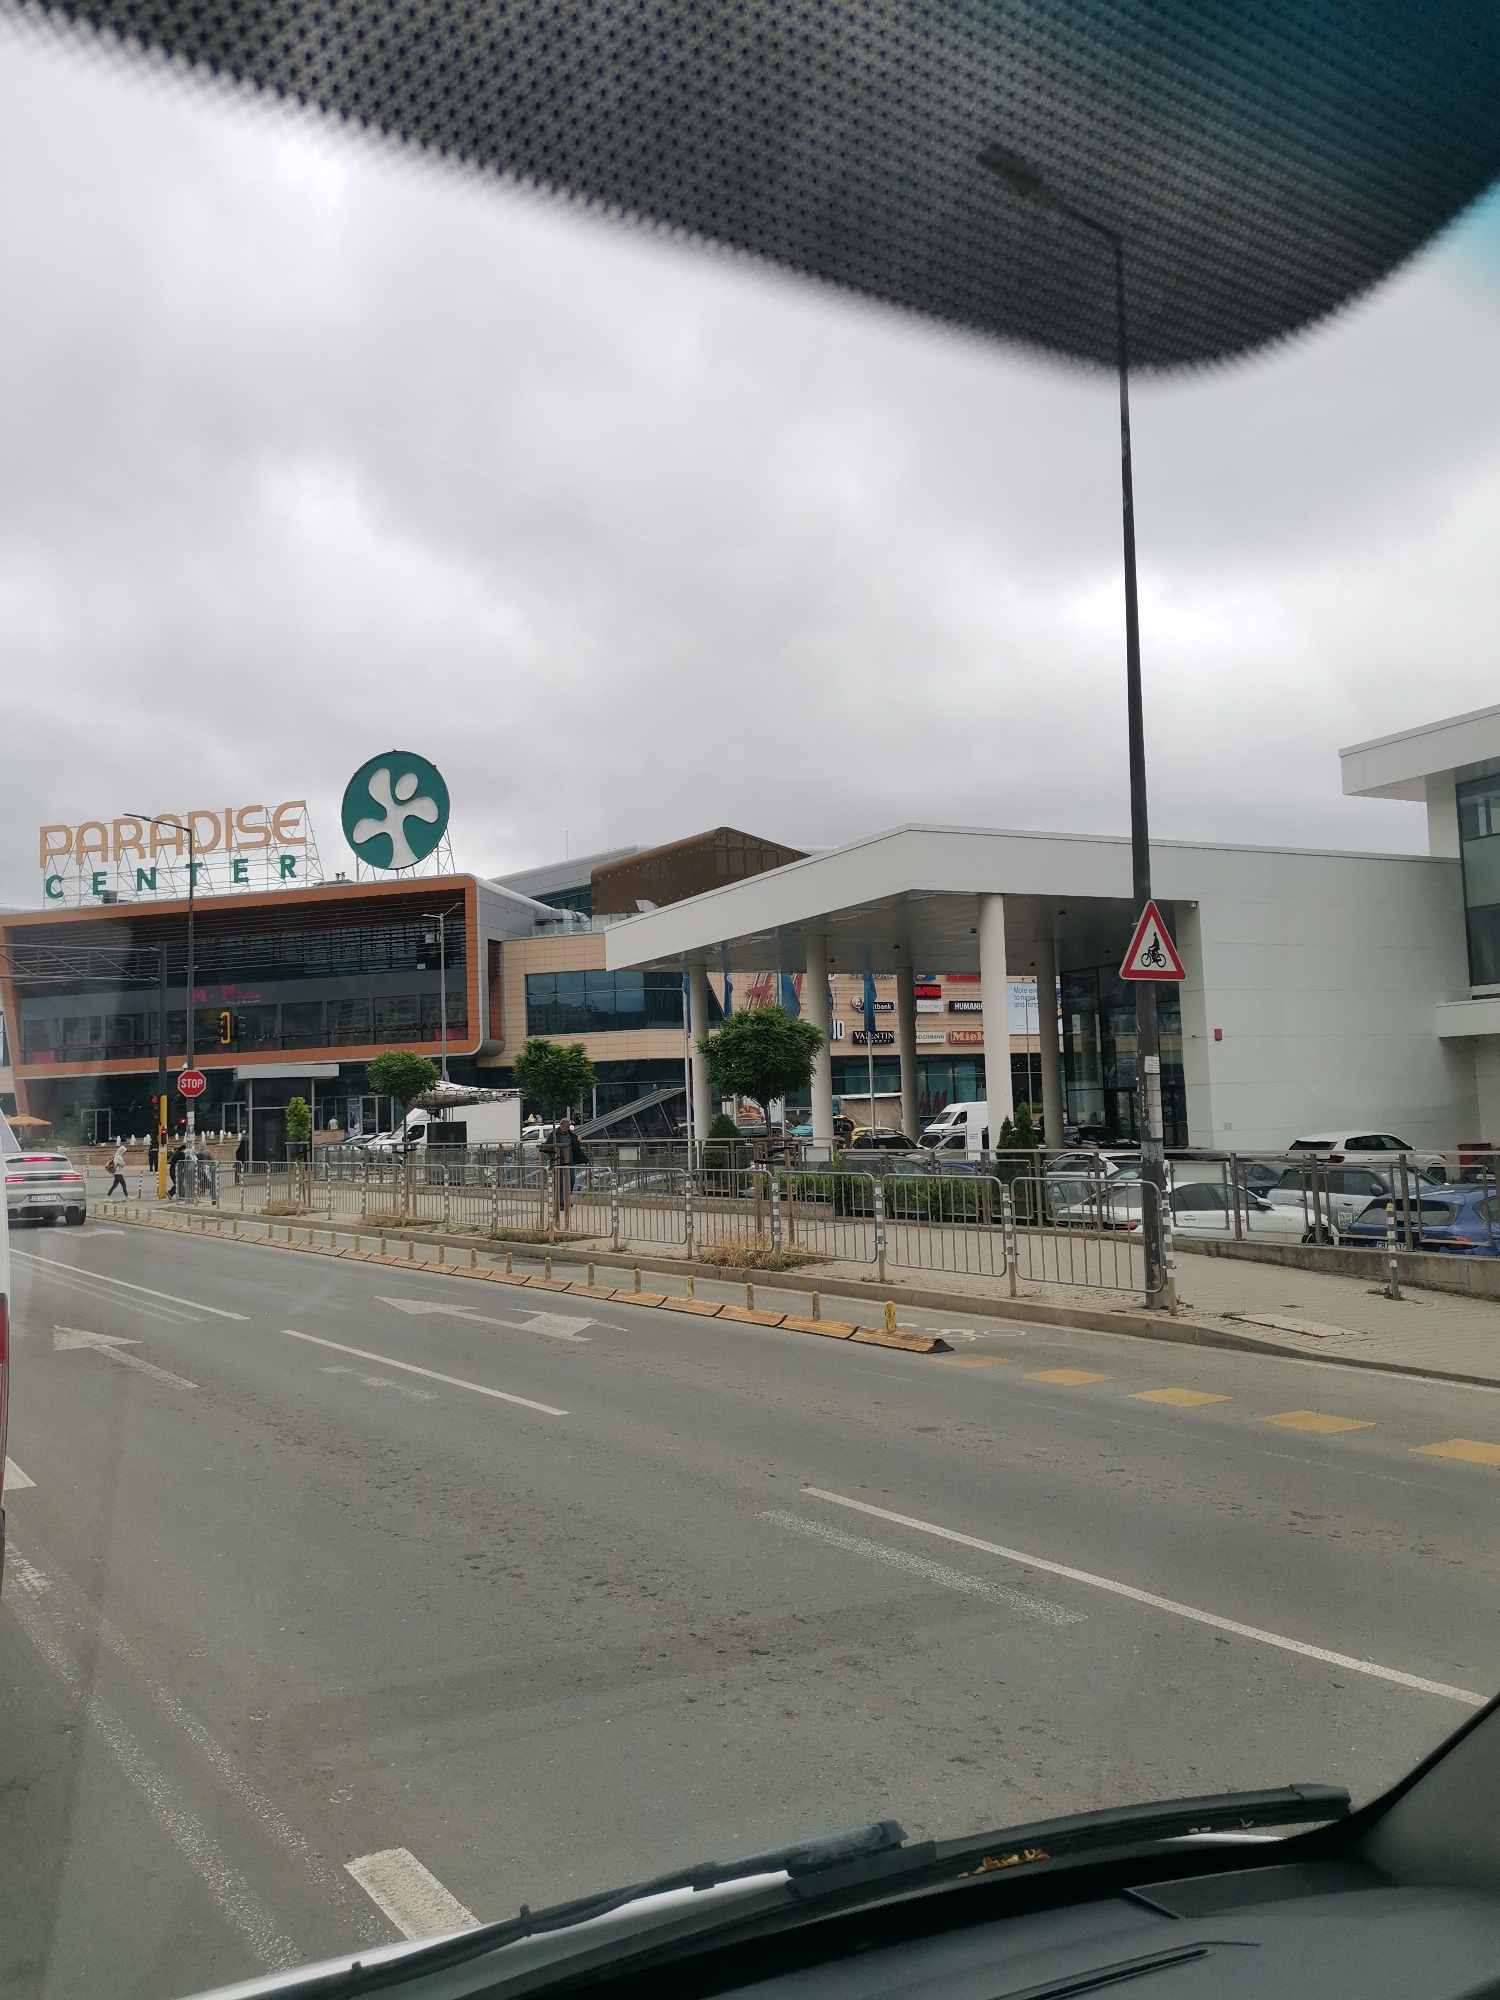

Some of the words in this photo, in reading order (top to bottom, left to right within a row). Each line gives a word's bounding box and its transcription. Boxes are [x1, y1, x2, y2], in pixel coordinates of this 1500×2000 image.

[40, 800, 307, 868] PARADISE
[45, 854, 297, 899] CENTER
[1013, 986, 1028, 994] More
[181, 1078, 203, 1088] STOP
